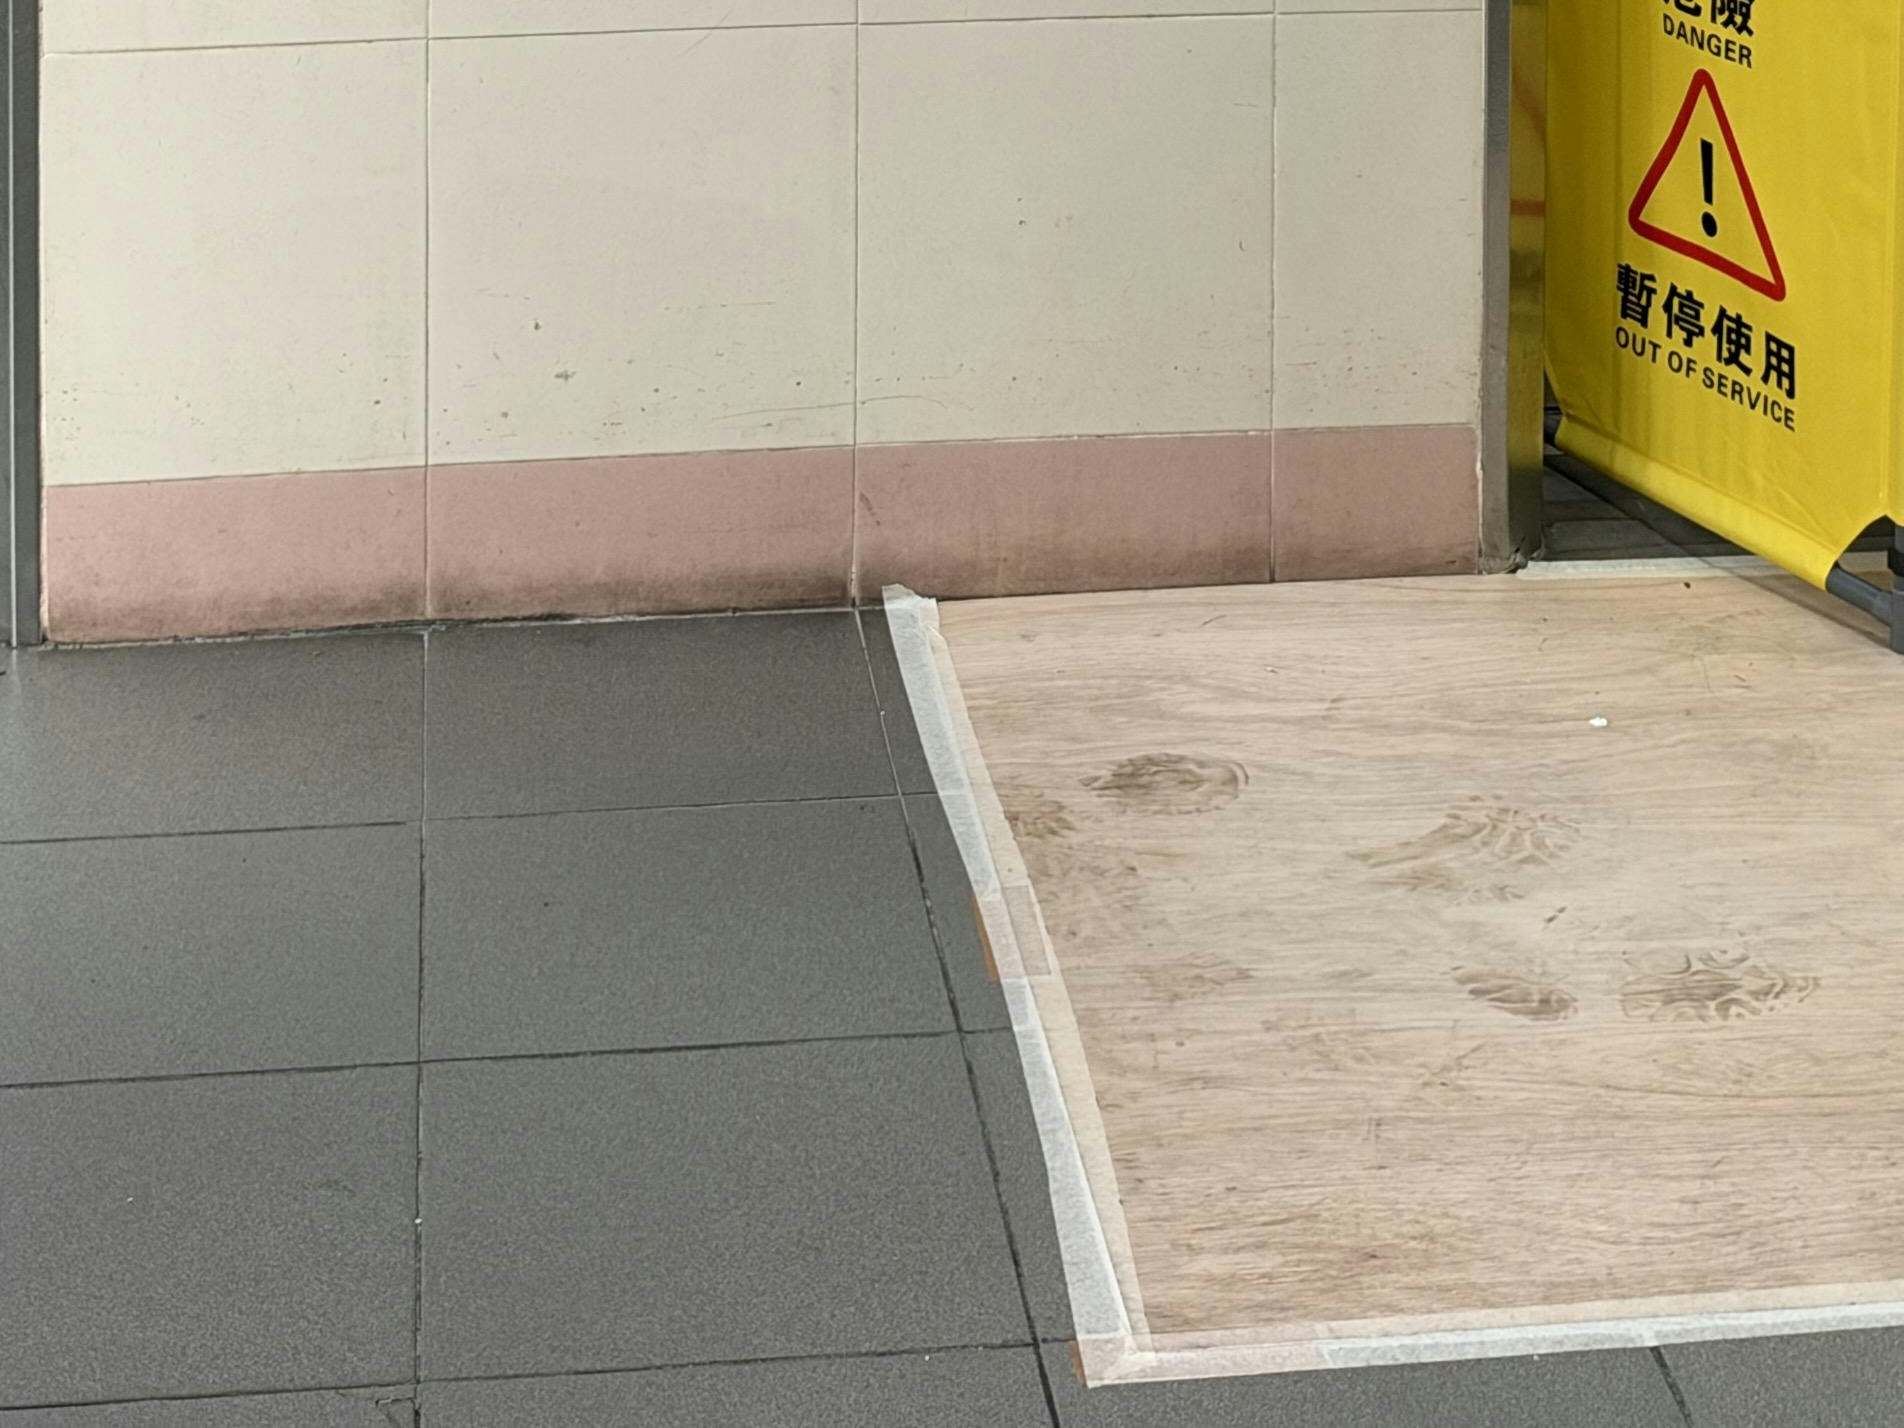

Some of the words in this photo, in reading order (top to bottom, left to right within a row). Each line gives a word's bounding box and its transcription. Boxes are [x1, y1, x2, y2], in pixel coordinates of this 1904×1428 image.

[1661, 12, 1754, 70] DANGER
[1615, 262, 1797, 402] 暫停使用
[1615, 325, 1662, 368] OUT
[1666, 349, 1698, 382] OF
[1701, 364, 1796, 433] SERVICE
